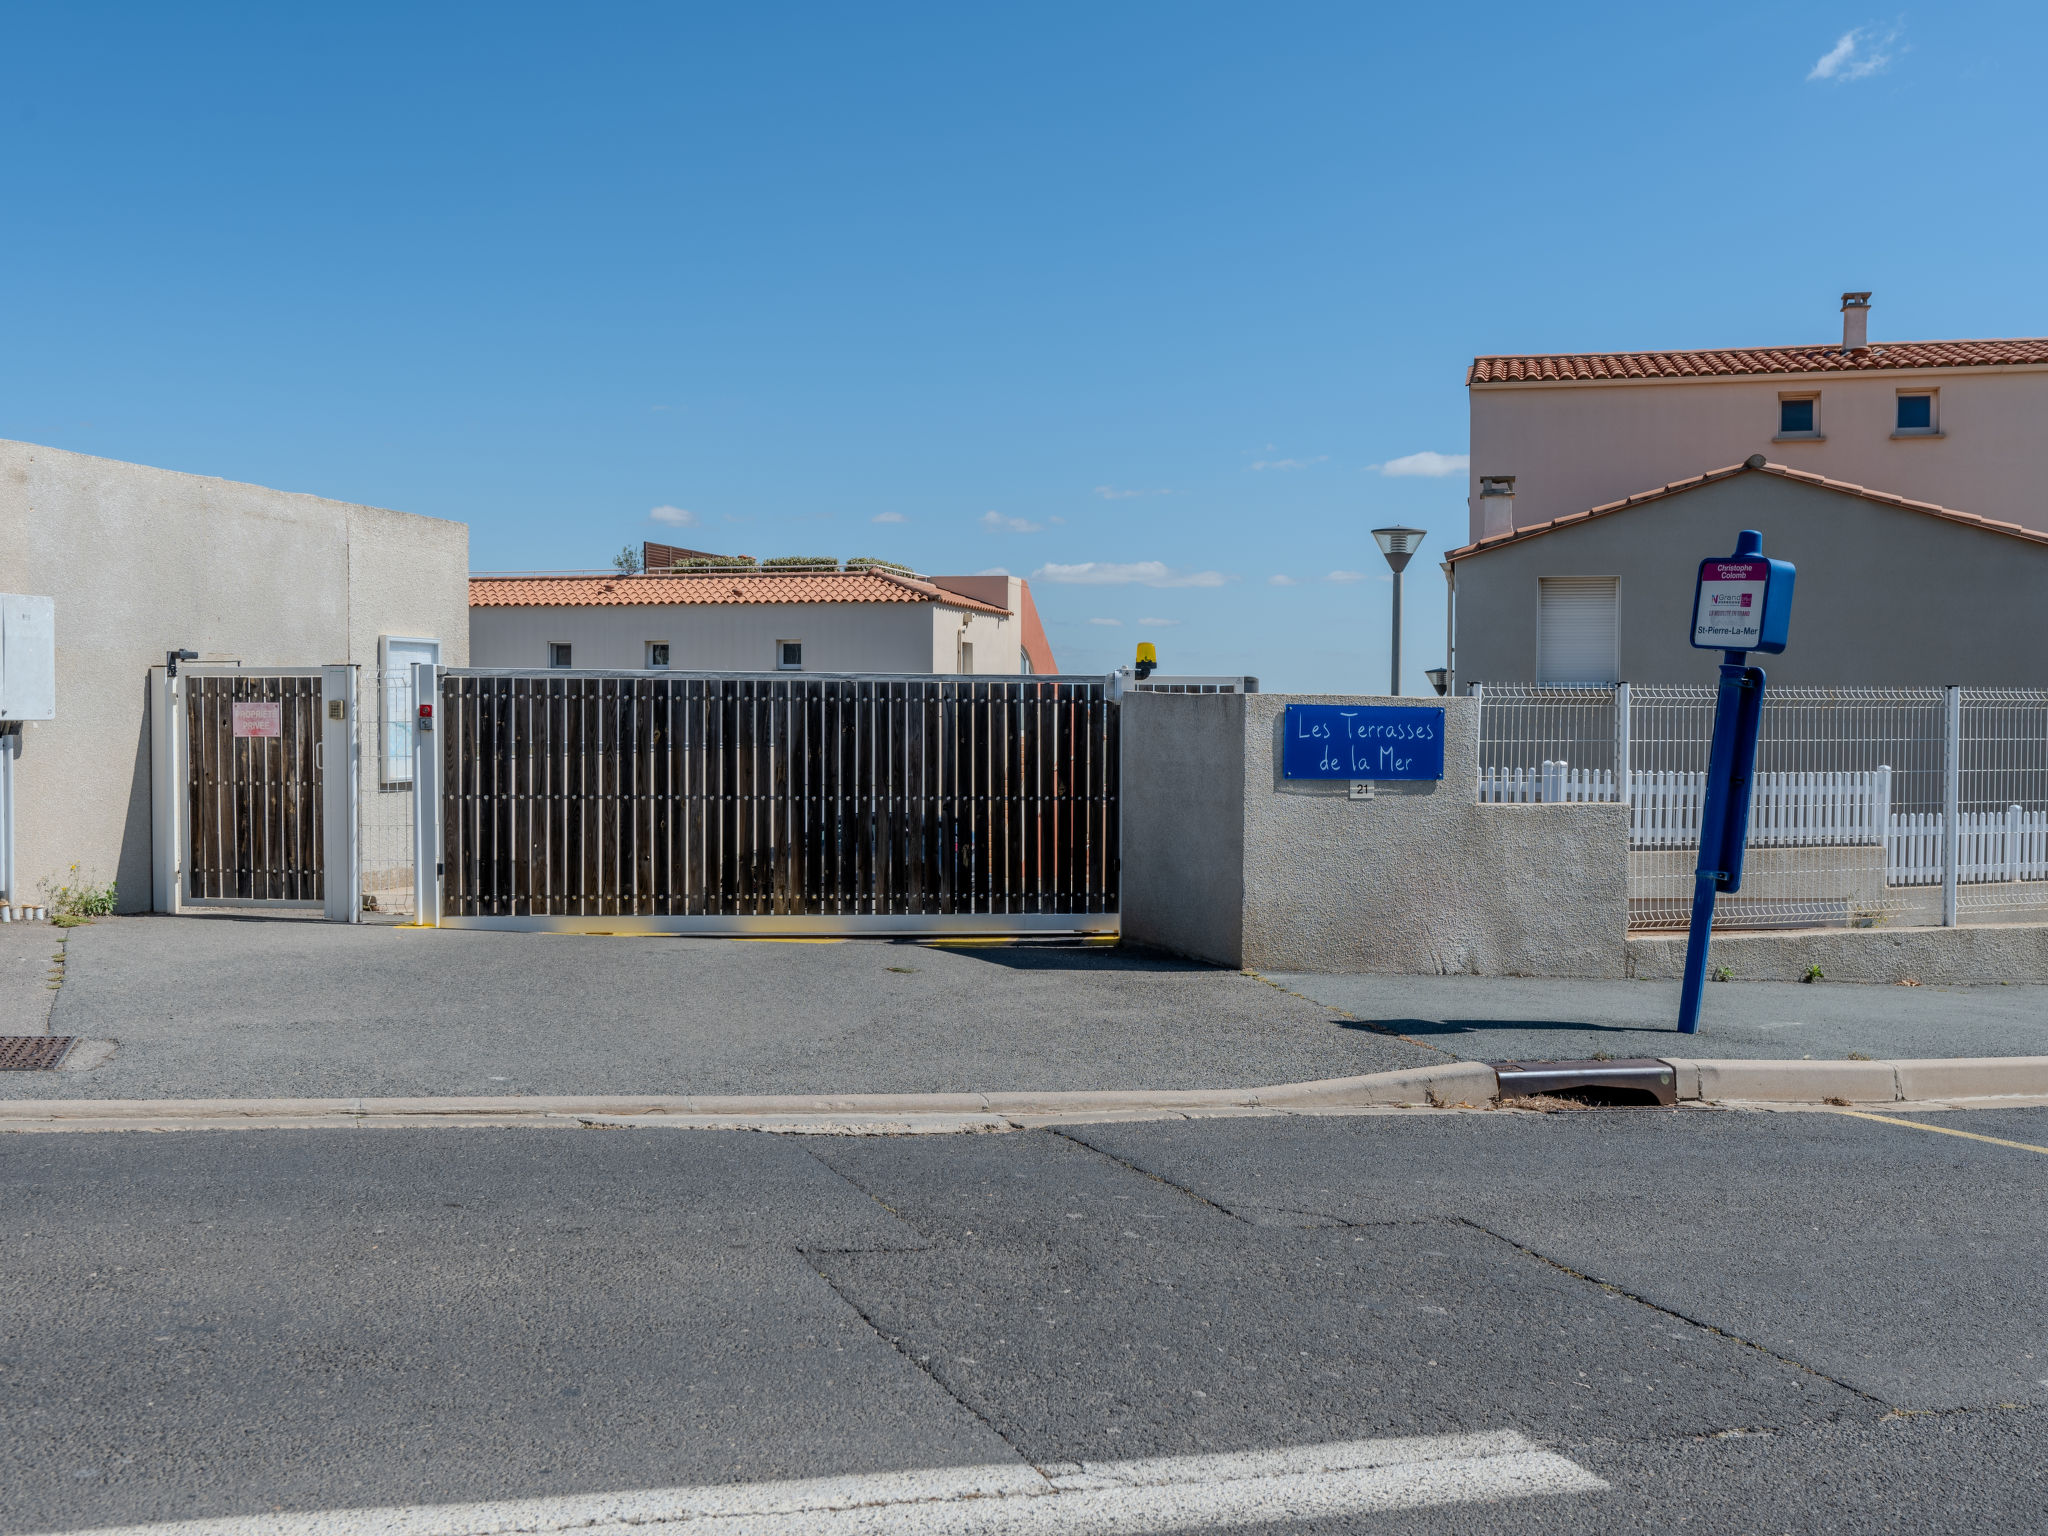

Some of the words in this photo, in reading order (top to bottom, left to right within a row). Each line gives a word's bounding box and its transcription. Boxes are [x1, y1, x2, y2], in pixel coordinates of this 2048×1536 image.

[1698, 626, 1758, 635] St-Pierre-La-Mer
[1298, 712, 1330, 739] Les
[1340, 712, 1434, 740] Terrasses
[1319, 745, 1341, 771] de
[1351, 744, 1371, 772] la
[1379, 745, 1413, 772] Mer
[1356, 783, 1368, 794] 21
